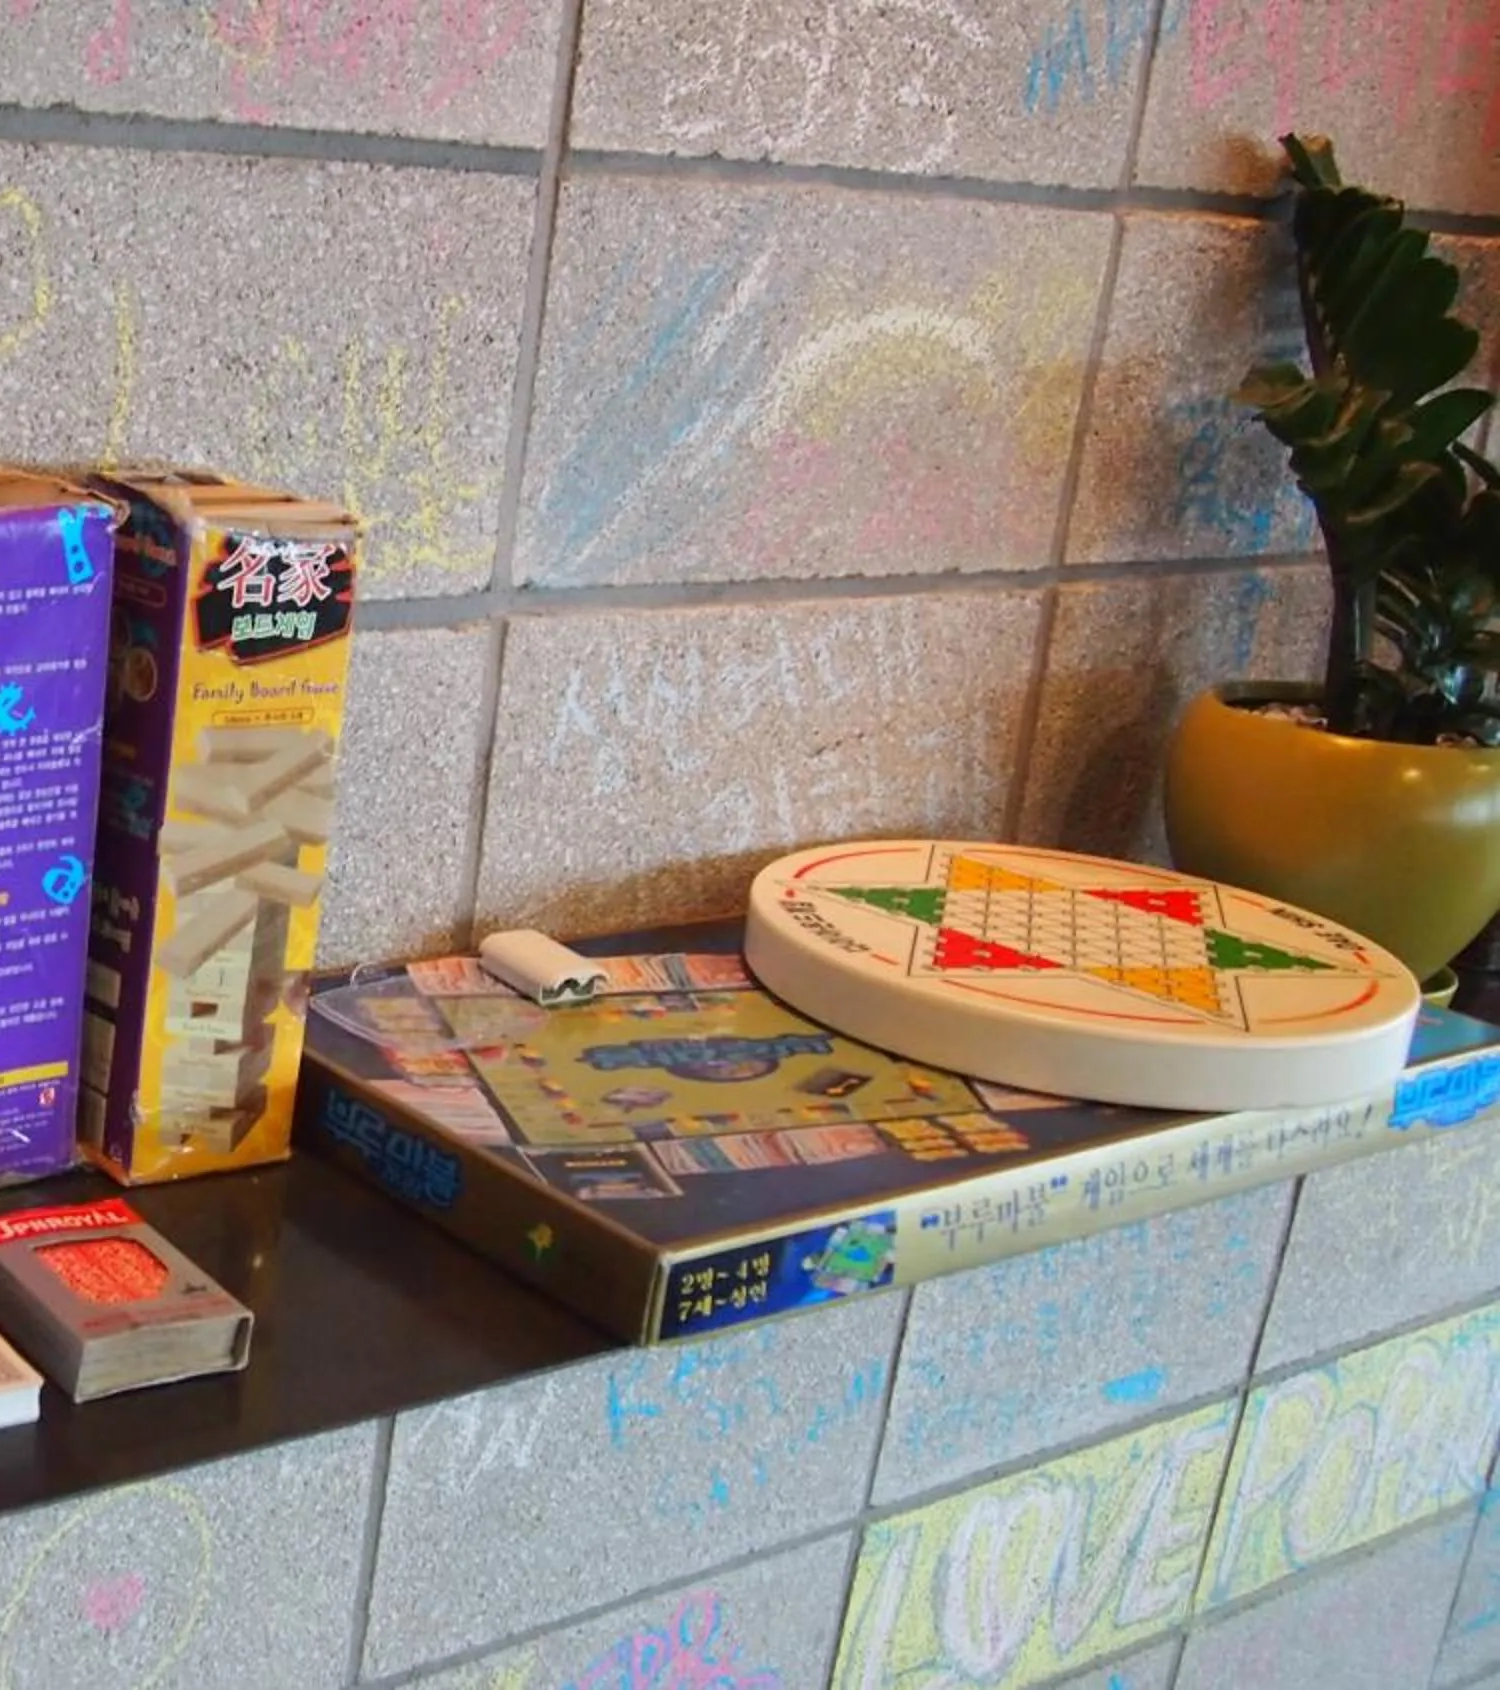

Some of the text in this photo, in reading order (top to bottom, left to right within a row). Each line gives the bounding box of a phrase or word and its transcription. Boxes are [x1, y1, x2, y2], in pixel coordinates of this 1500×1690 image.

[217, 535, 337, 608] 名家
[193, 679, 341, 704] Family Board Game
